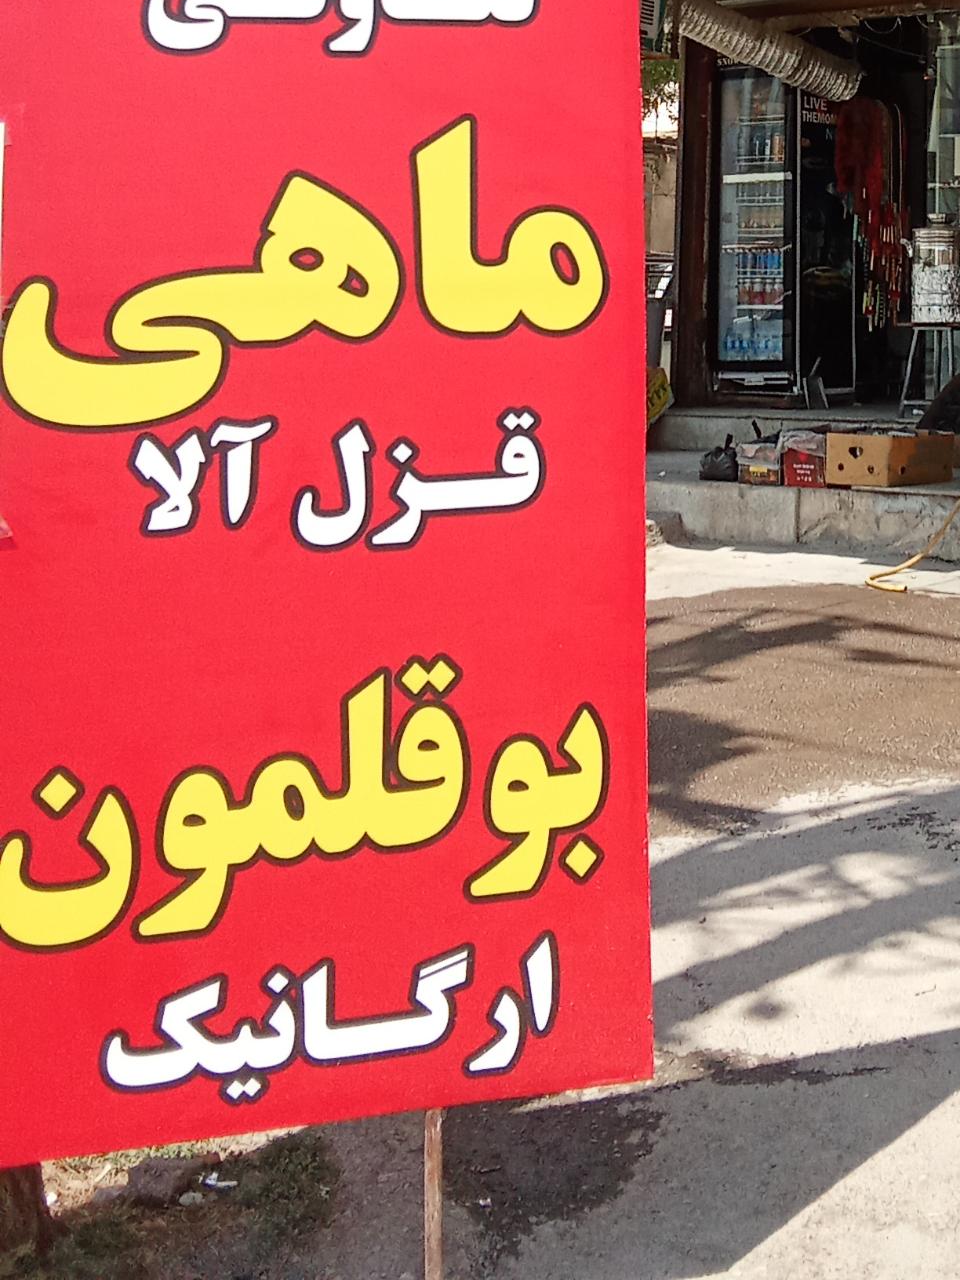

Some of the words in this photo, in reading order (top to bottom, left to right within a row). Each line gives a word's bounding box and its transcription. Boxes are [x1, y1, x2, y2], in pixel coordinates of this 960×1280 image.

[803, 96, 828, 111] LIVE
[0, 114, 608, 430] ماهی
[130, 416, 275, 536] آلا
[292, 410, 547, 552] قزل
[0, 655, 608, 952] بوقلمون
[100, 932, 559, 1107] ارگانیک
